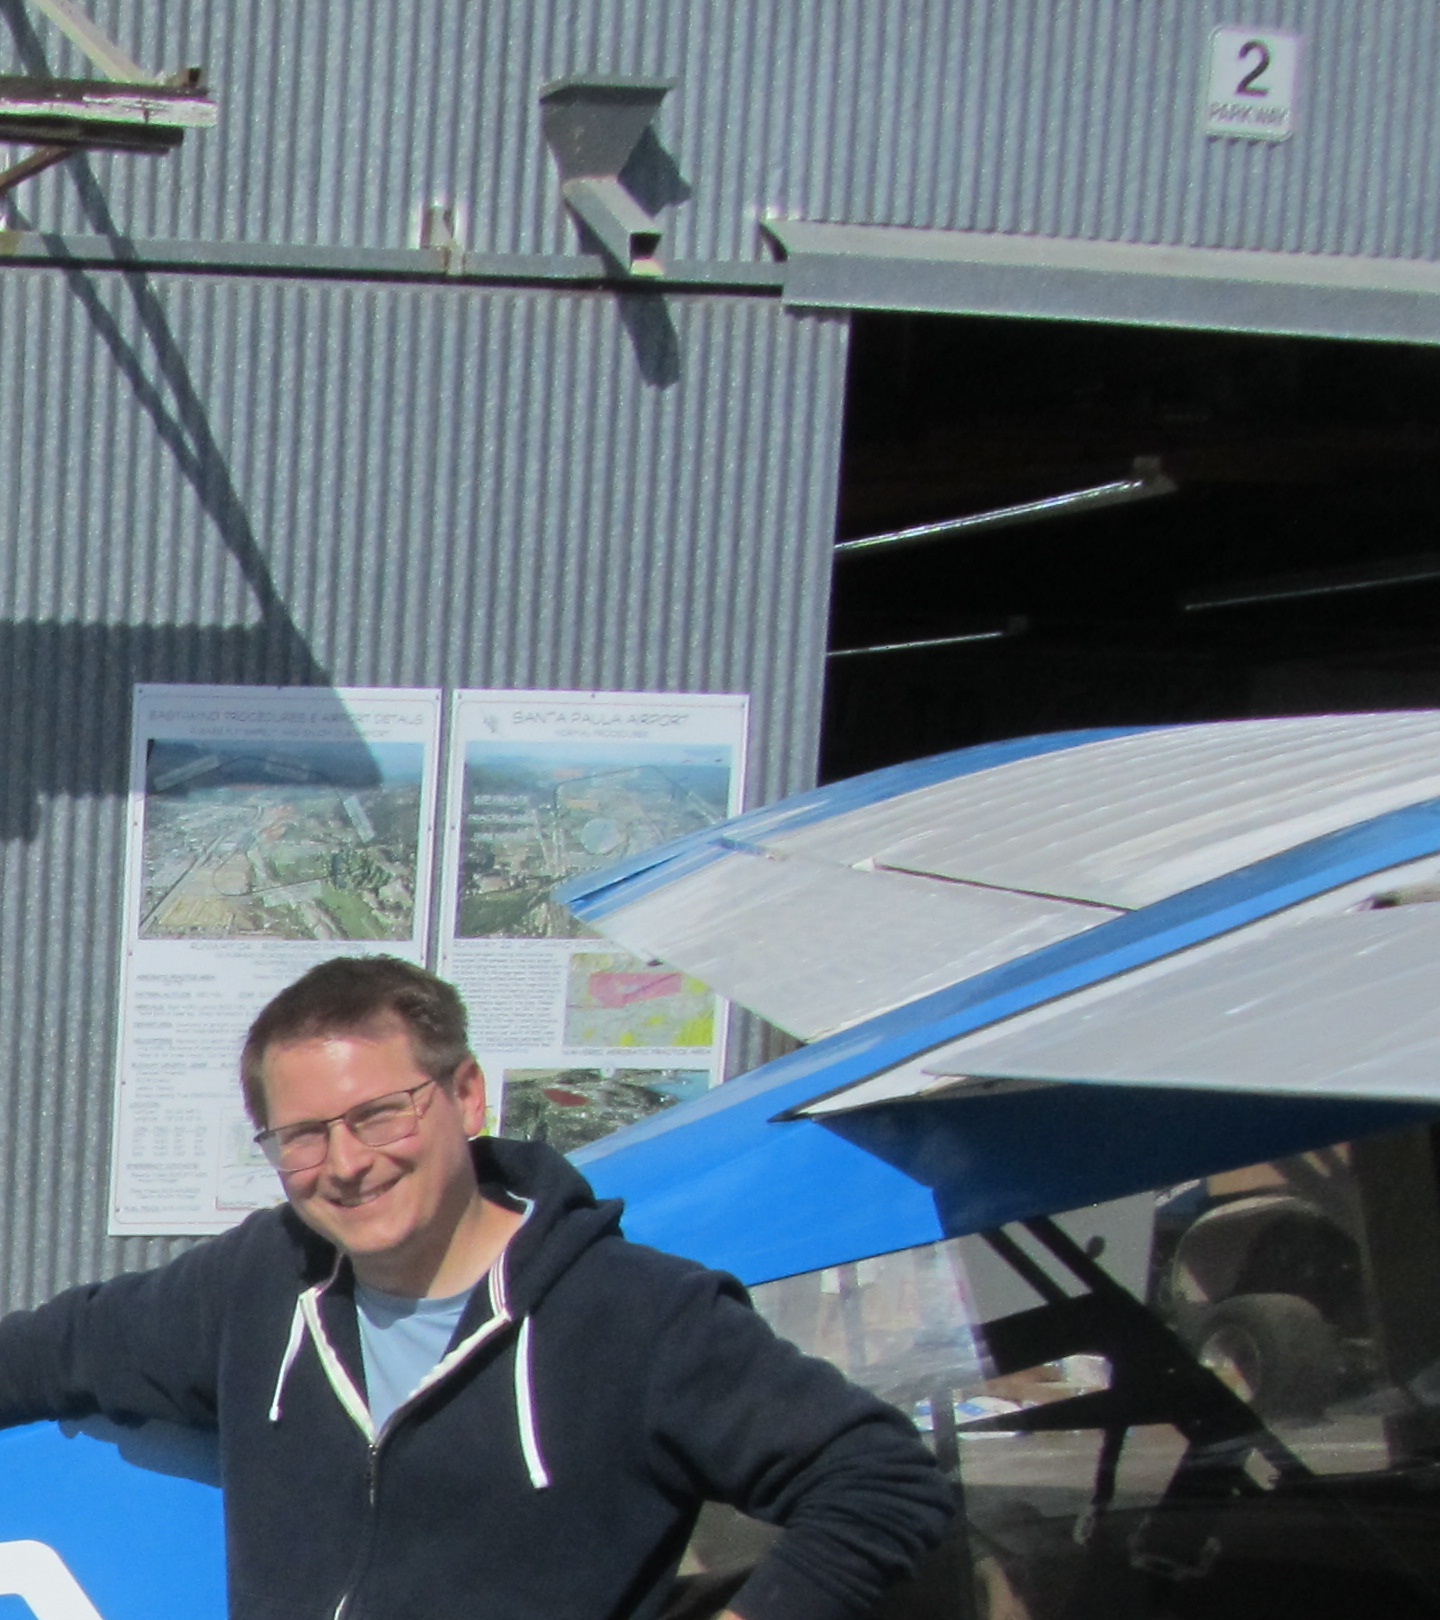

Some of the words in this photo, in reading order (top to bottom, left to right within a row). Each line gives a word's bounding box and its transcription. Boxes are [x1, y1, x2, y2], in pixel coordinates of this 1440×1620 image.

[1236, 39, 1270, 97] 2
[512, 711, 566, 725] SANTA
[572, 712, 621, 726] PAULA
[626, 713, 690, 728] AIRPORT
